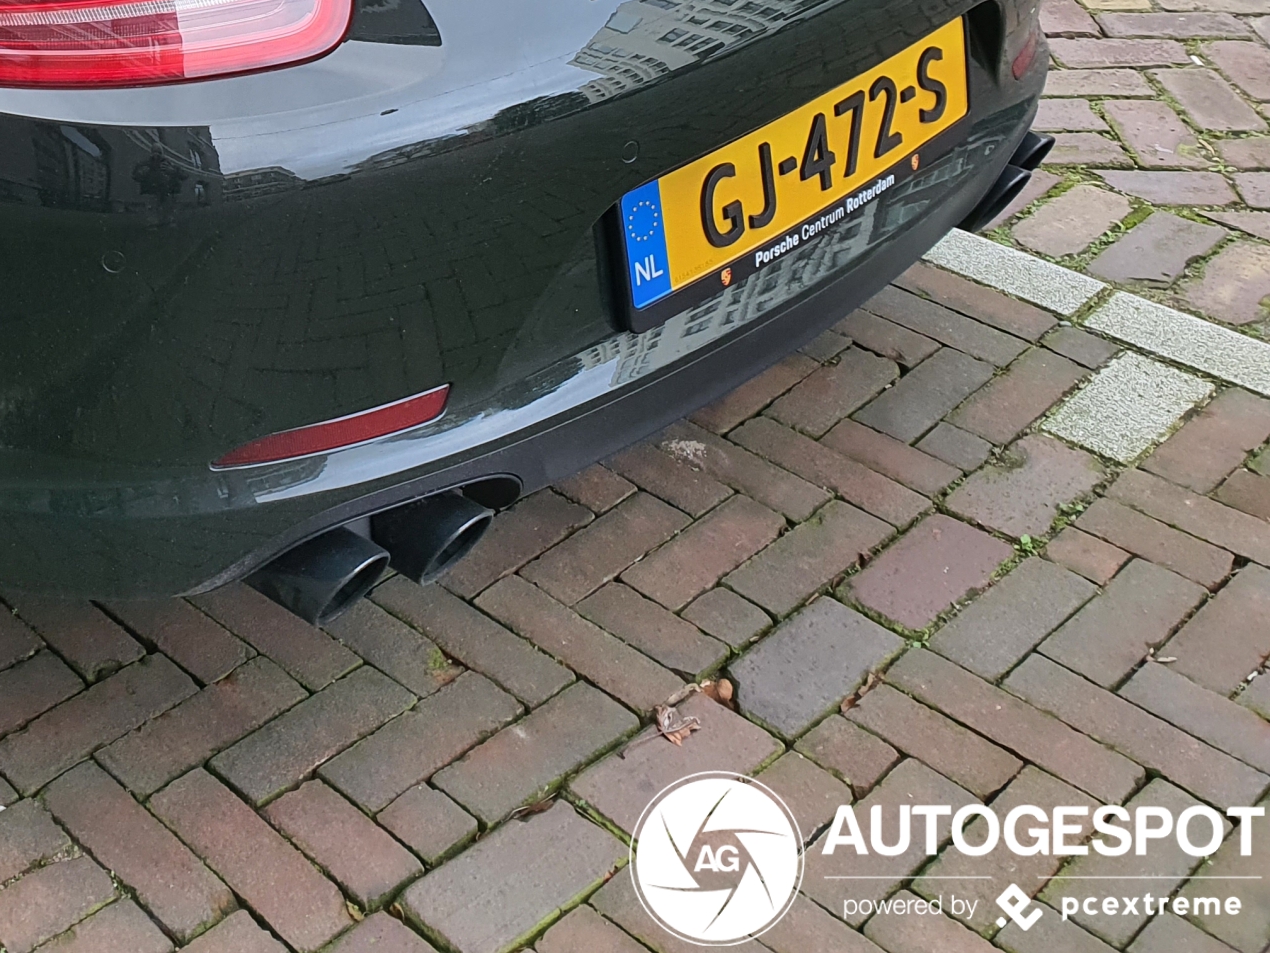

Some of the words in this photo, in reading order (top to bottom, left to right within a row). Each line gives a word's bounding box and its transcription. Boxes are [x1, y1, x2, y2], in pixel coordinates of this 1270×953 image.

[700, 46, 947, 248] GJ-472-S
[755, 234, 800, 268] Porsche
[801, 206, 845, 240] Centrum
[846, 174, 895, 214] Rotterdam
[634, 254, 664, 286] NL
